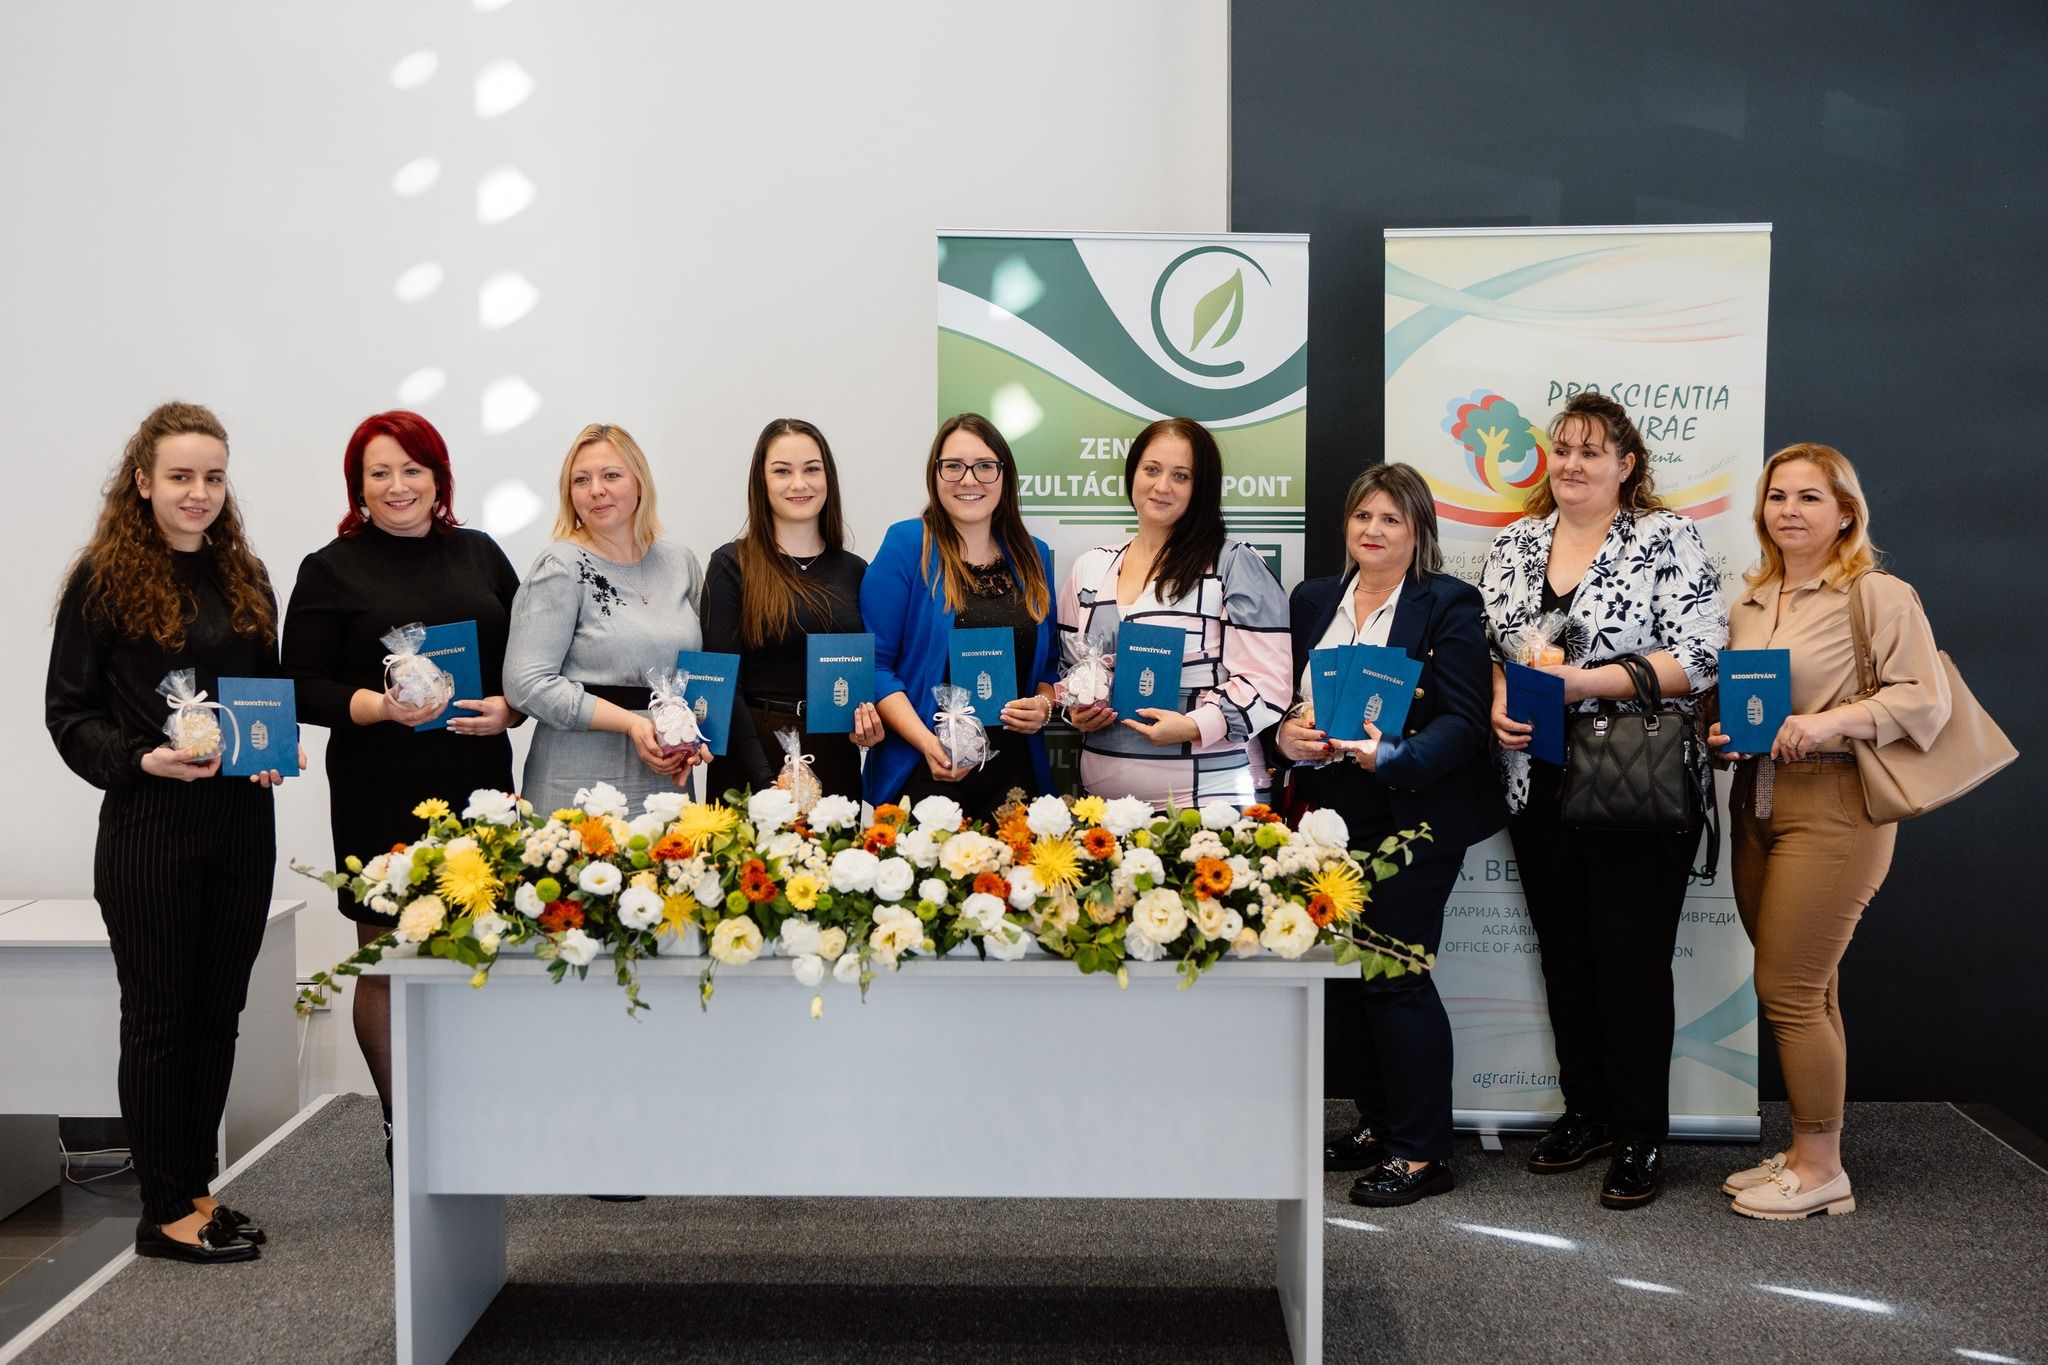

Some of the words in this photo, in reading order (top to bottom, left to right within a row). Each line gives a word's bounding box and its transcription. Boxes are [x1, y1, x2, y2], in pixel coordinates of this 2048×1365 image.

[1610, 383, 1729, 410] SCIENTIA
[1221, 475, 1293, 497] PONT
[1129, 644, 1171, 655] BIZONYÍTVÁNY
[819, 655, 863, 663] BIZONYÍTVÁNY
[687, 674, 725, 683] IZONYÍTVÁNY
[1362, 668, 1404, 686] BIZONYÍTVÁNY
[1503, 907, 1521, 918] ЗА
[1445, 941, 1490, 953] OFFICE
[1492, 942, 1511, 953] OF
